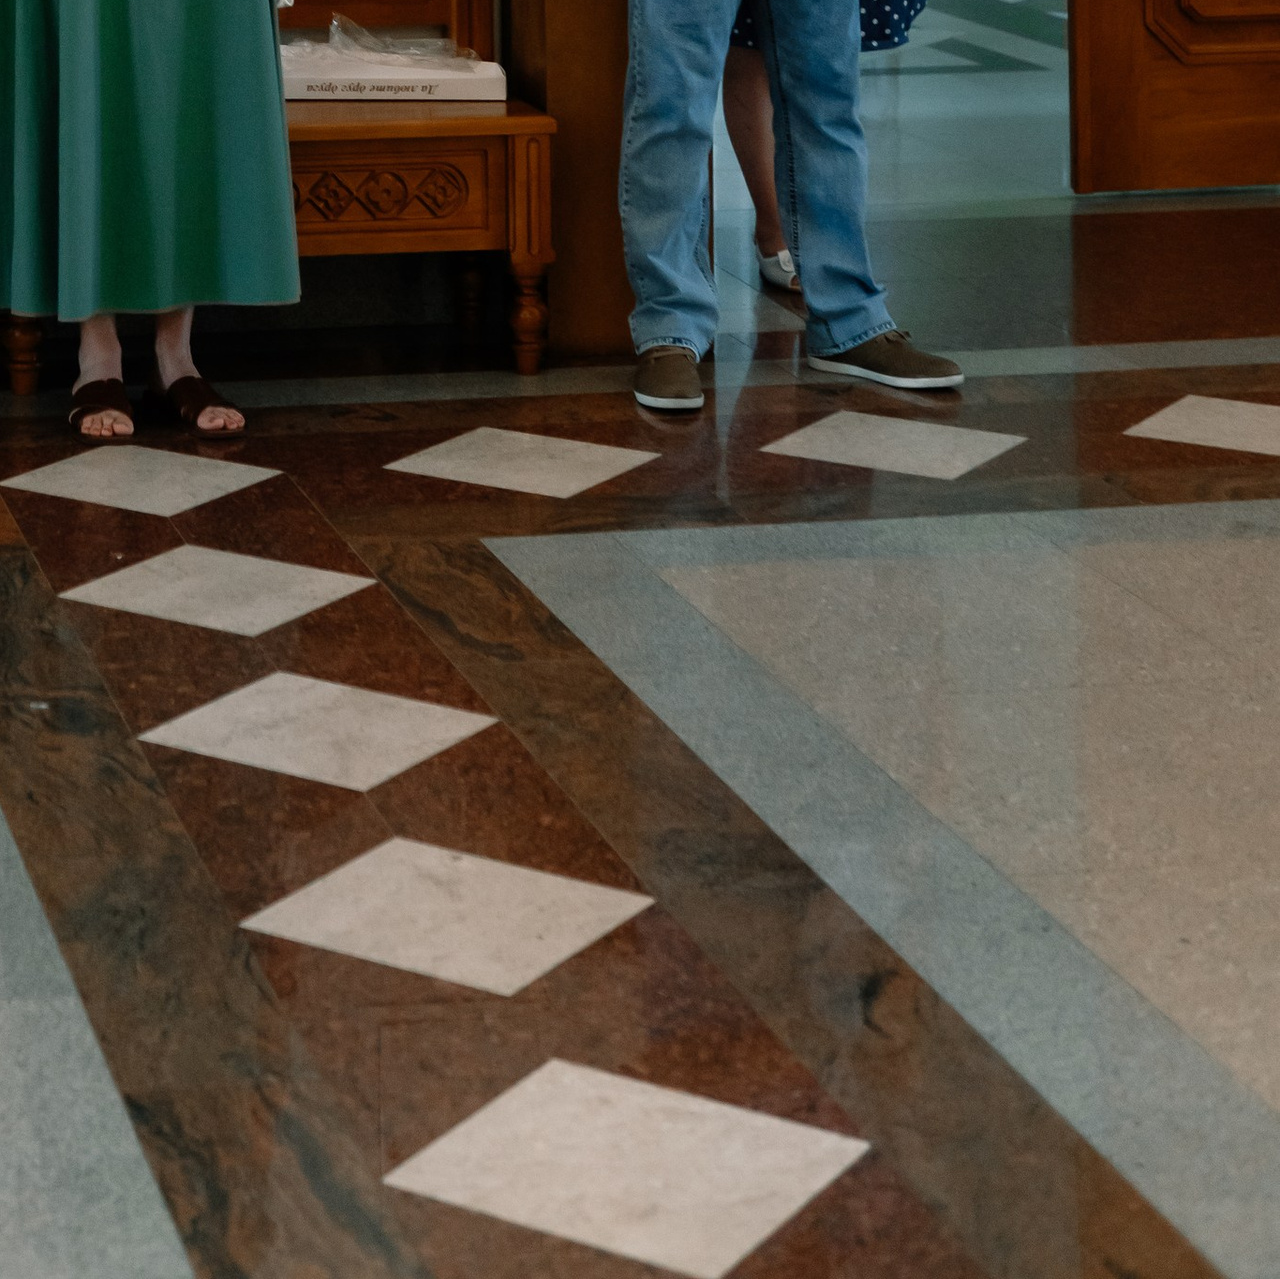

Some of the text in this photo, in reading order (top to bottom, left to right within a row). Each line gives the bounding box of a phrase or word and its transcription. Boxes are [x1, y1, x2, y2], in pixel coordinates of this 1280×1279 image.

[307, 82, 439, 95] Да любите друг друга
